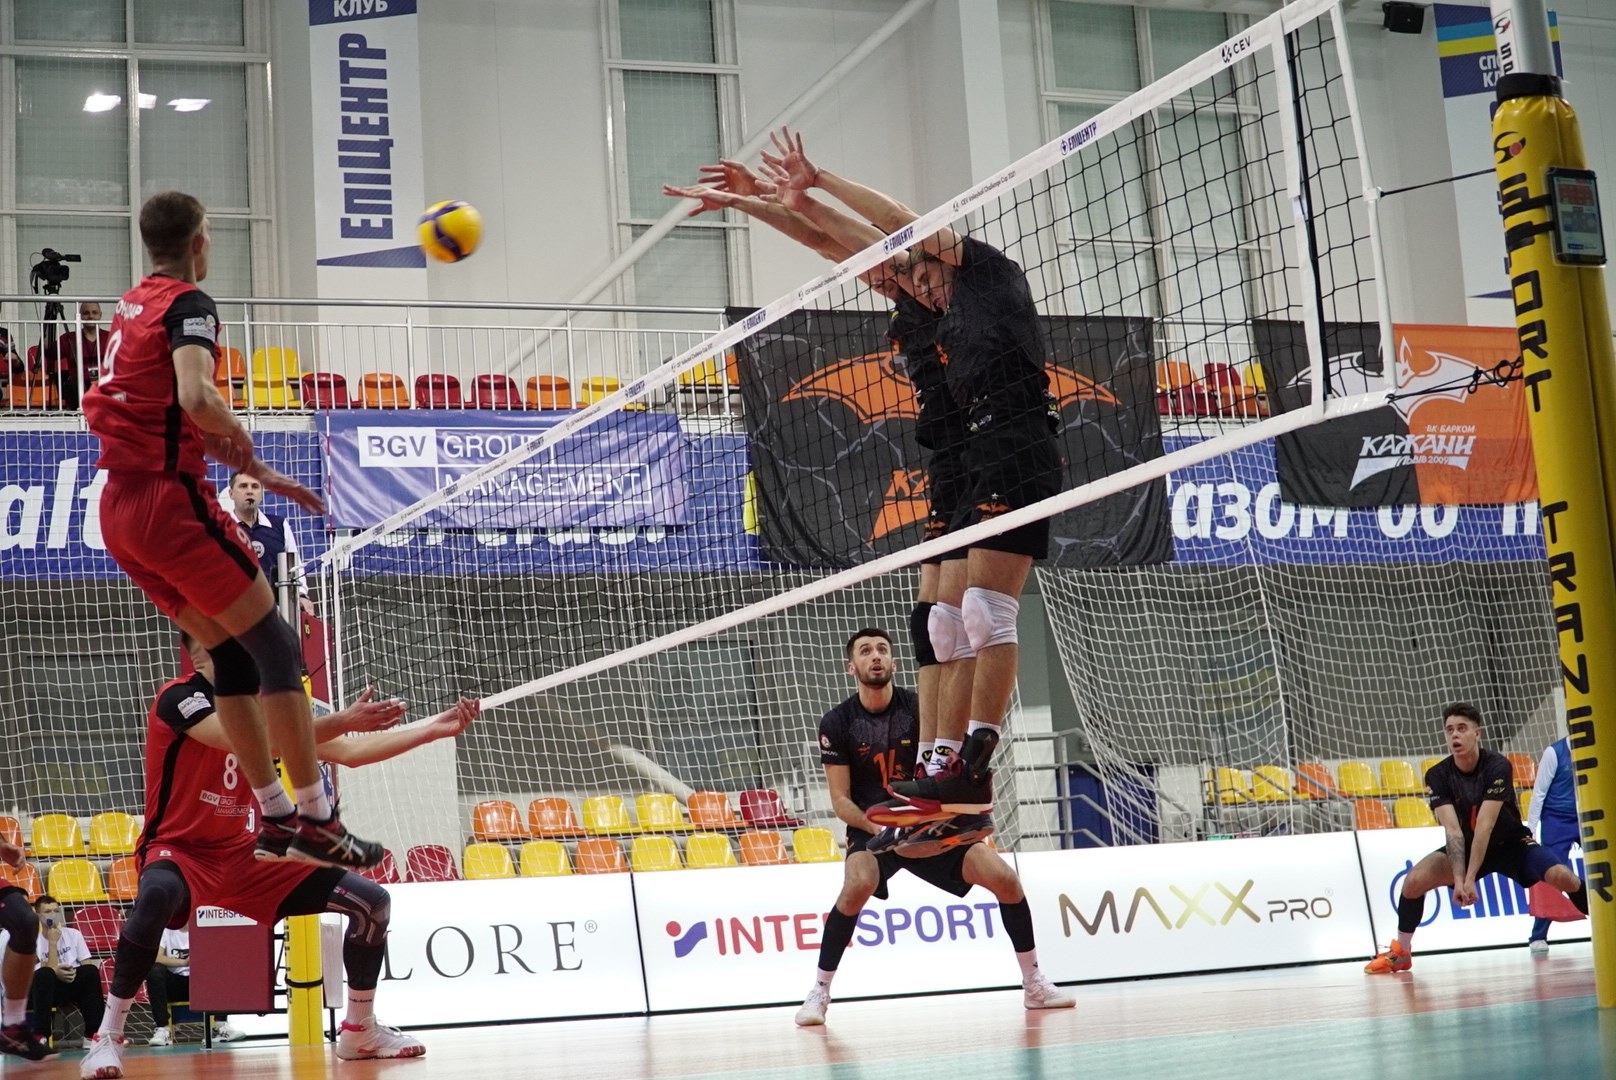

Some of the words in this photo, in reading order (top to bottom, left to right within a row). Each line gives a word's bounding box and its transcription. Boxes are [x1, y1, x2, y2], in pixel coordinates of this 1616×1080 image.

[1232, 35, 1251, 54] CEV
[337, 33, 394, 240] ЕПІЦЕНТР
[1068, 121, 1097, 151] ЕПІЦЕНТР
[98, 329, 123, 387] 9
[368, 435, 426, 458] BGV
[443, 434, 541, 458] GROU
[223, 753, 239, 790] 8
[201, 792, 218, 803] BGV
[205, 908, 247, 919] INTERS
[1058, 878, 1262, 938] MAXX
[1266, 896, 1333, 923] PRO
[714, 902, 999, 956] INTESPORT
[380, 920, 584, 981] LORE
